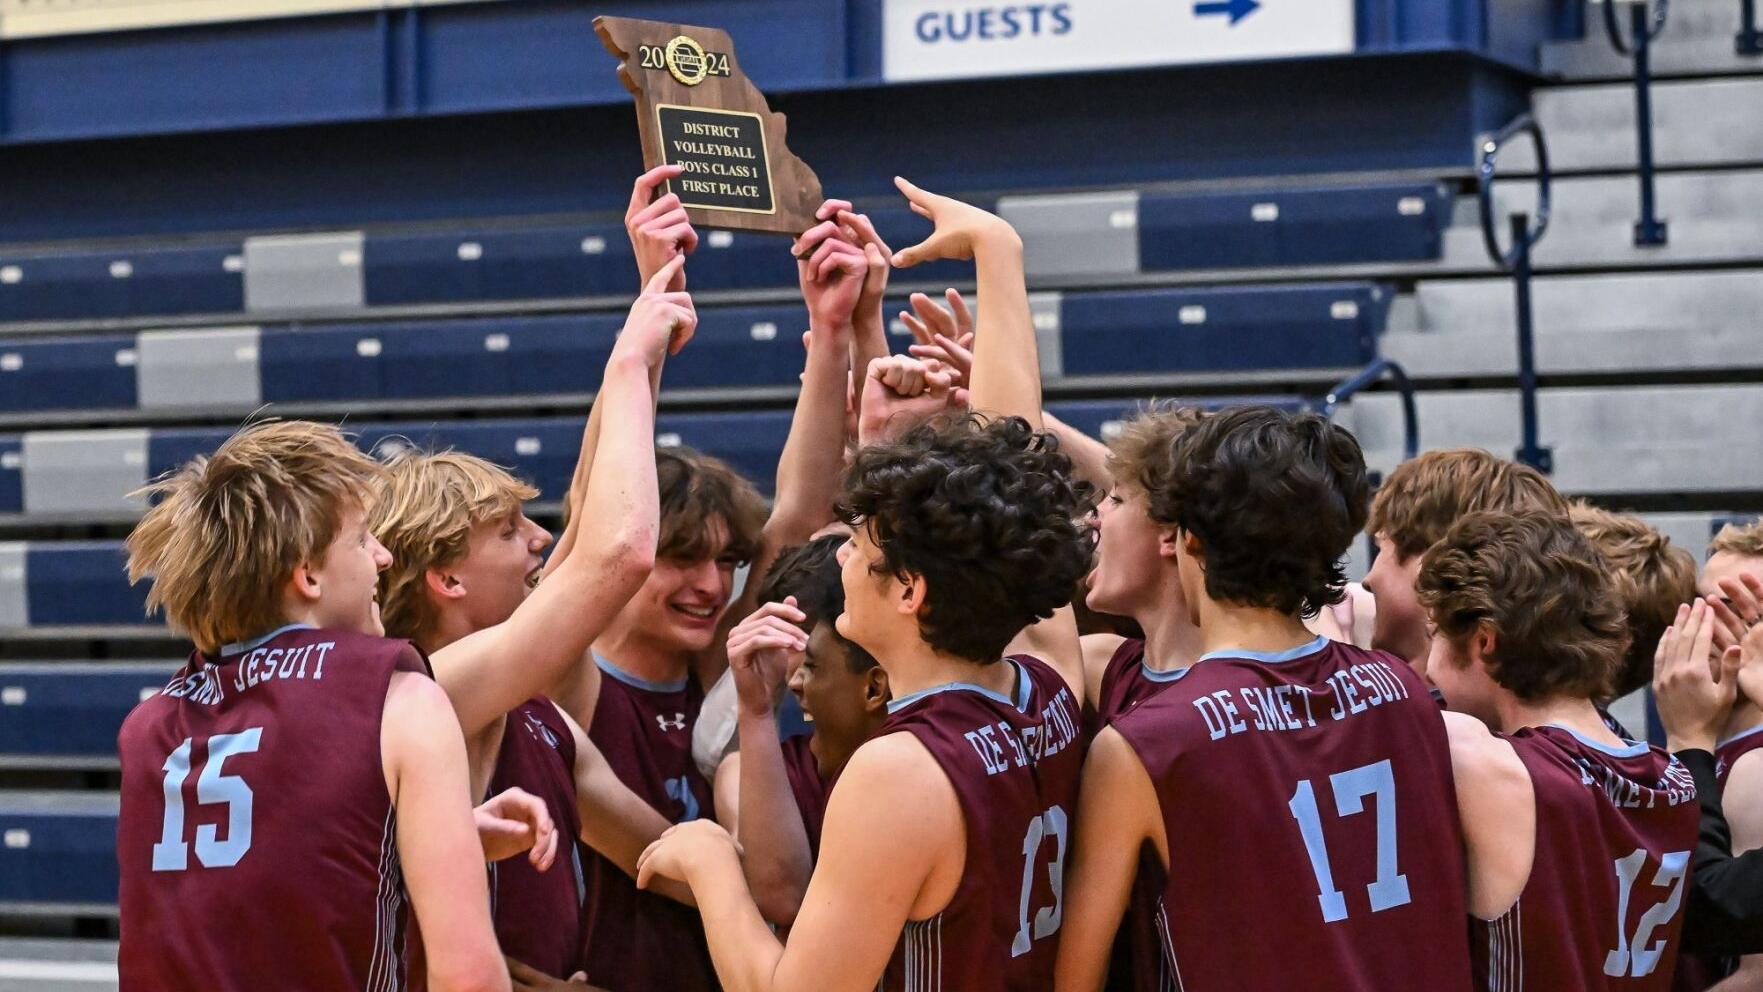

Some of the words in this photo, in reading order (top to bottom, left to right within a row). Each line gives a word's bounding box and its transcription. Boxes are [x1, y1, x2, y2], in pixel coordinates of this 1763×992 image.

[915, 3, 1073, 43] GUESTS
[639, 45, 665, 69] 20
[706, 53, 731, 76] 24
[673, 140, 756, 159] VOLLEYBALL
[682, 122, 740, 139] DISTRICT
[677, 160, 710, 174] BOYS
[711, 163, 750, 178] CLASS
[752, 167, 758, 178] 1
[682, 180, 716, 194] FIRST
[719, 183, 760, 198] PLACE
[234, 641, 336, 692] JESUIT
[1192, 689, 1248, 741] DE
[1241, 684, 1317, 732] SMET
[1325, 661, 1409, 721] JESUIT
[963, 724, 1008, 776] DE
[152, 727, 263, 872] 15
[1288, 759, 1412, 923] 17
[1011, 804, 1067, 958] 13
[1603, 848, 1691, 977] 12
